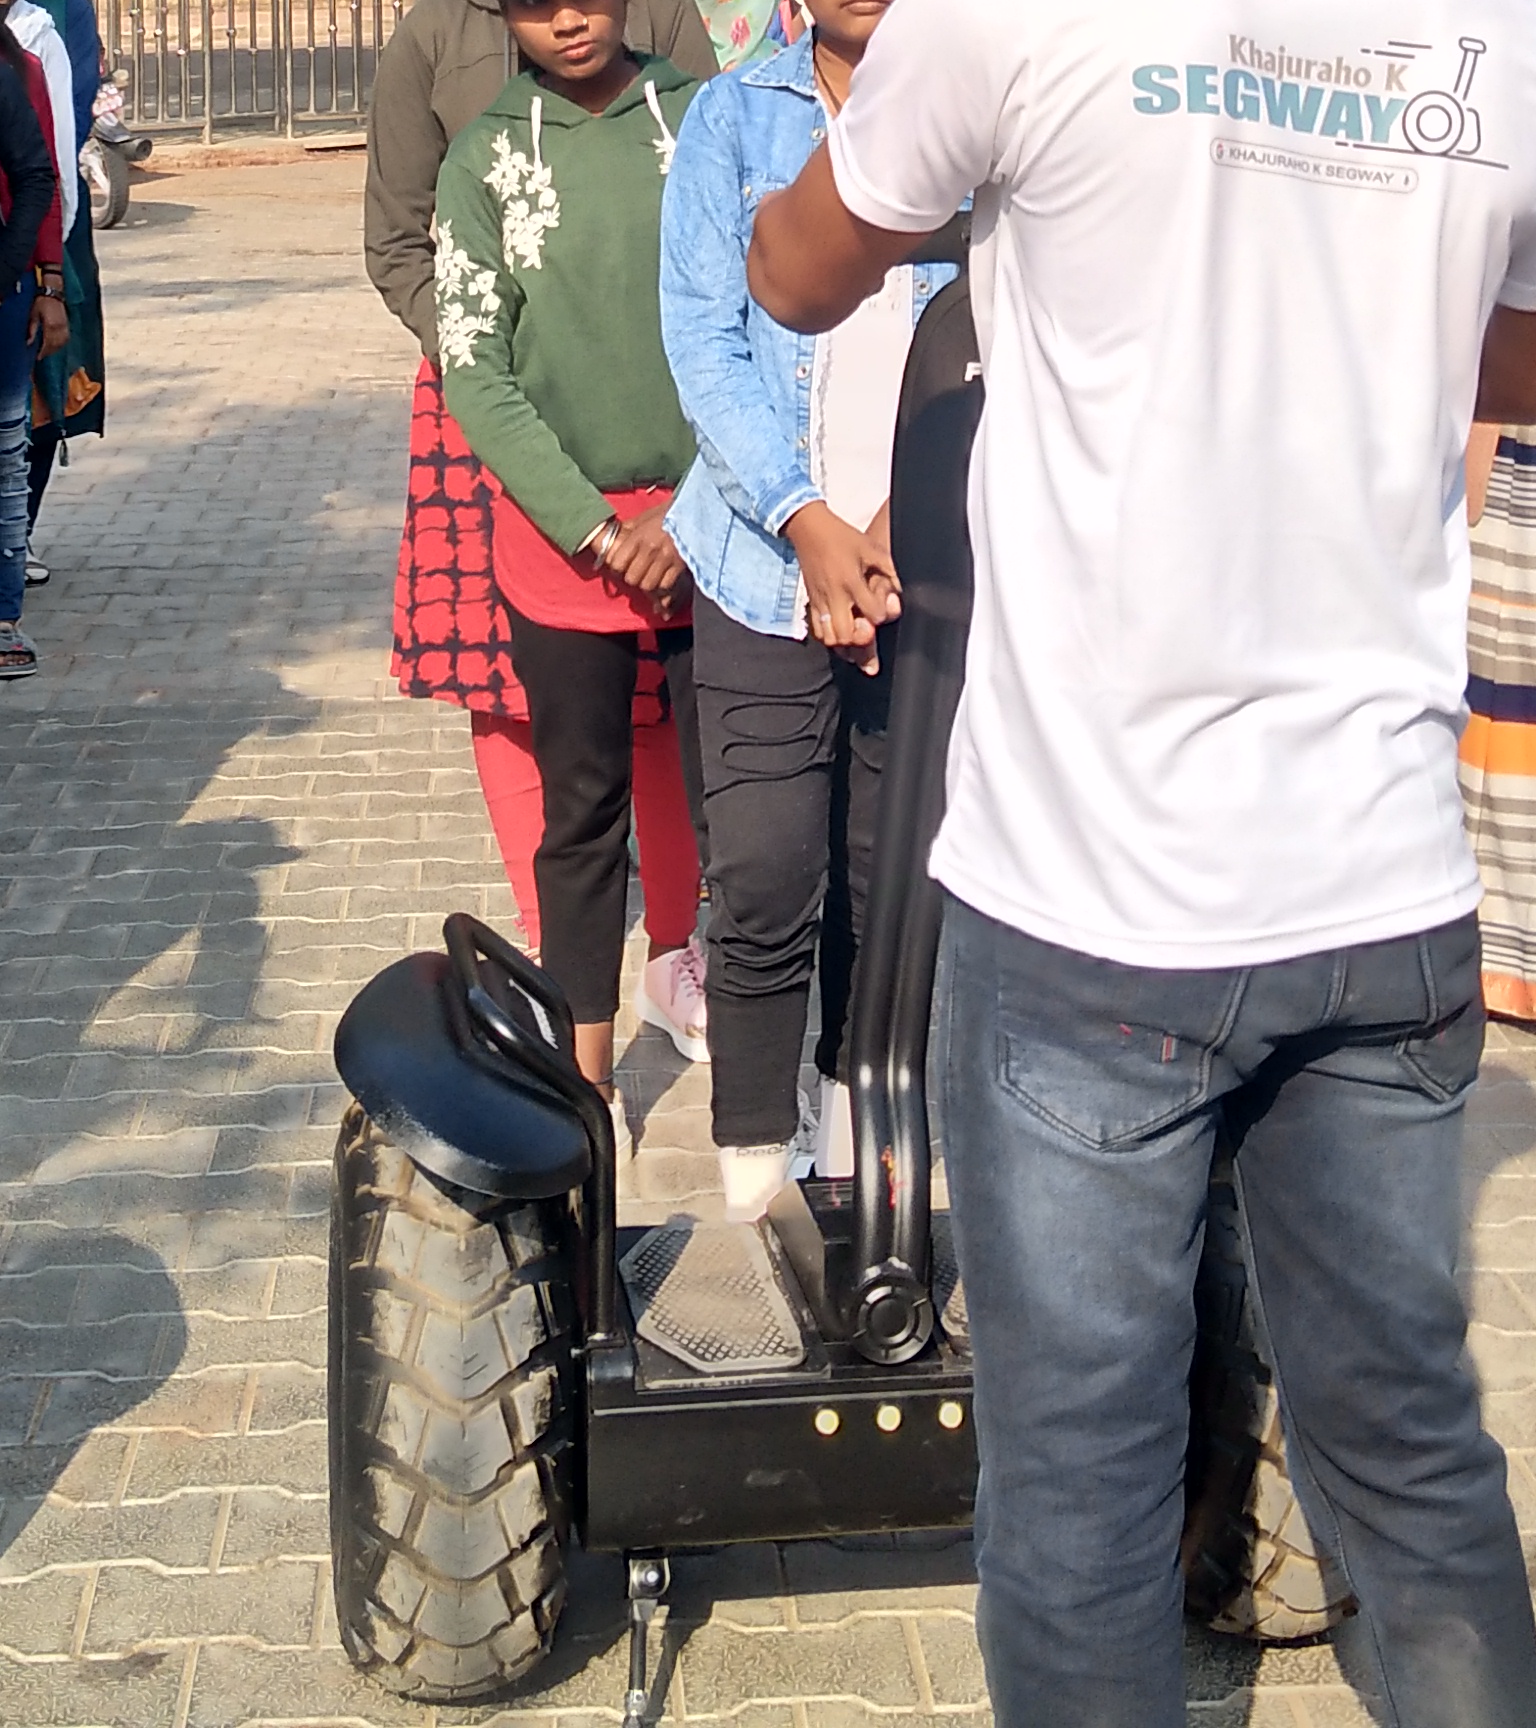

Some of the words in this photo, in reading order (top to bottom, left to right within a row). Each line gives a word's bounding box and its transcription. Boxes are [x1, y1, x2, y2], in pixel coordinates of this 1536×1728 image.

[1228, 34, 1372, 88] Khajuraho
[1384, 63, 1408, 92] K
[1132, 64, 1407, 144] SEGWAY
[1229, 147, 1309, 173] KHAJURAHO
[1313, 163, 1323, 175] K
[1325, 166, 1395, 185] SEGWAY
